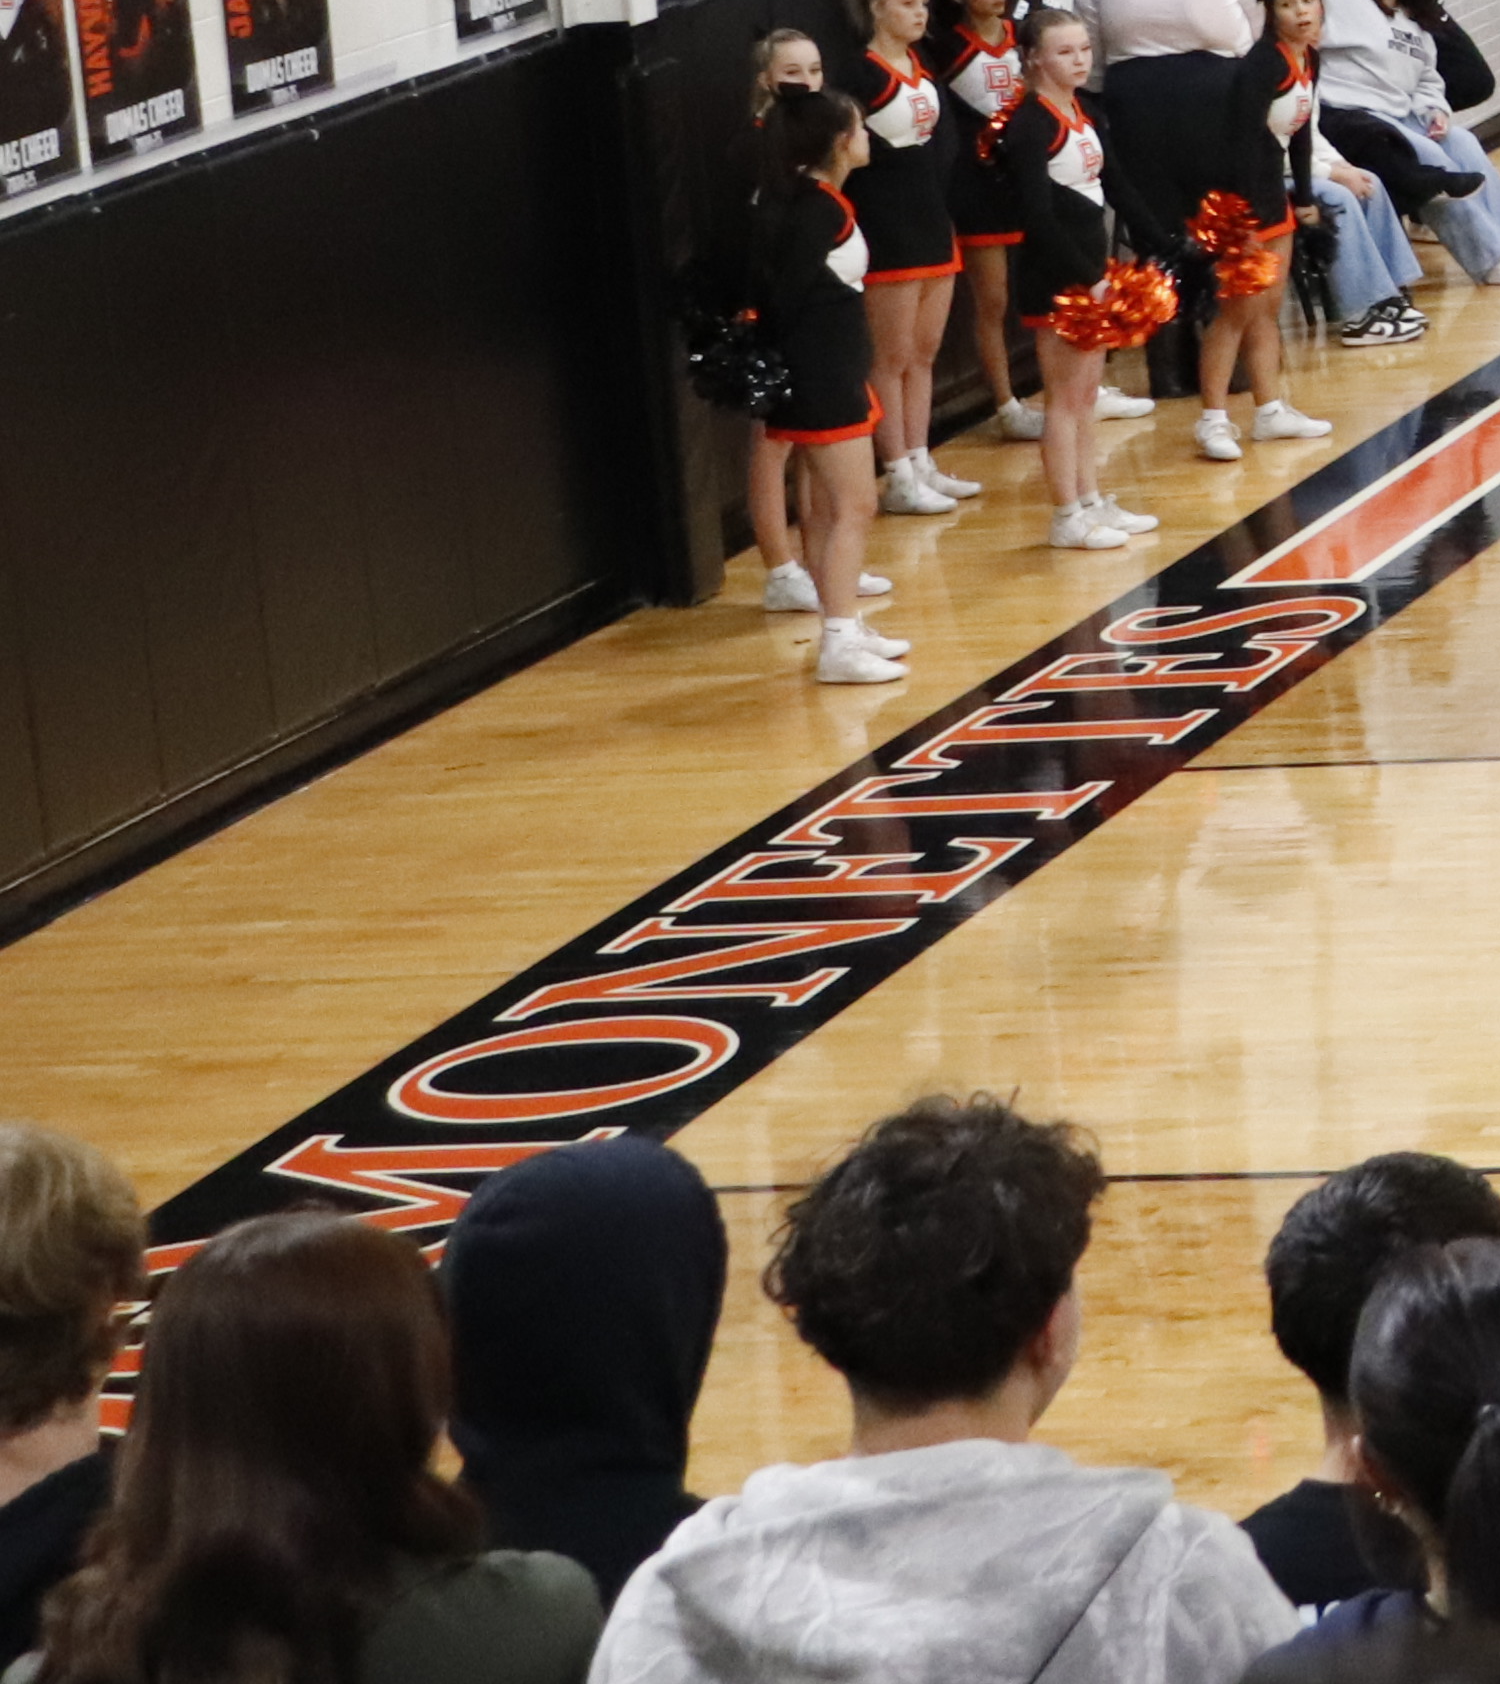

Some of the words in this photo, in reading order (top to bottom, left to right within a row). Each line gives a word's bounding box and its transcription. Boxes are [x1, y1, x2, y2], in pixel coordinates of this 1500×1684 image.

[245, 55, 285, 94] DUMAS
[284, 45, 319, 81] CHEER
[105, 100, 148, 145] DUMAS
[148, 87, 186, 132] CHEER
[21, 127, 61, 170] CHEER
[97, 593, 1366, 1437] MONETTES
